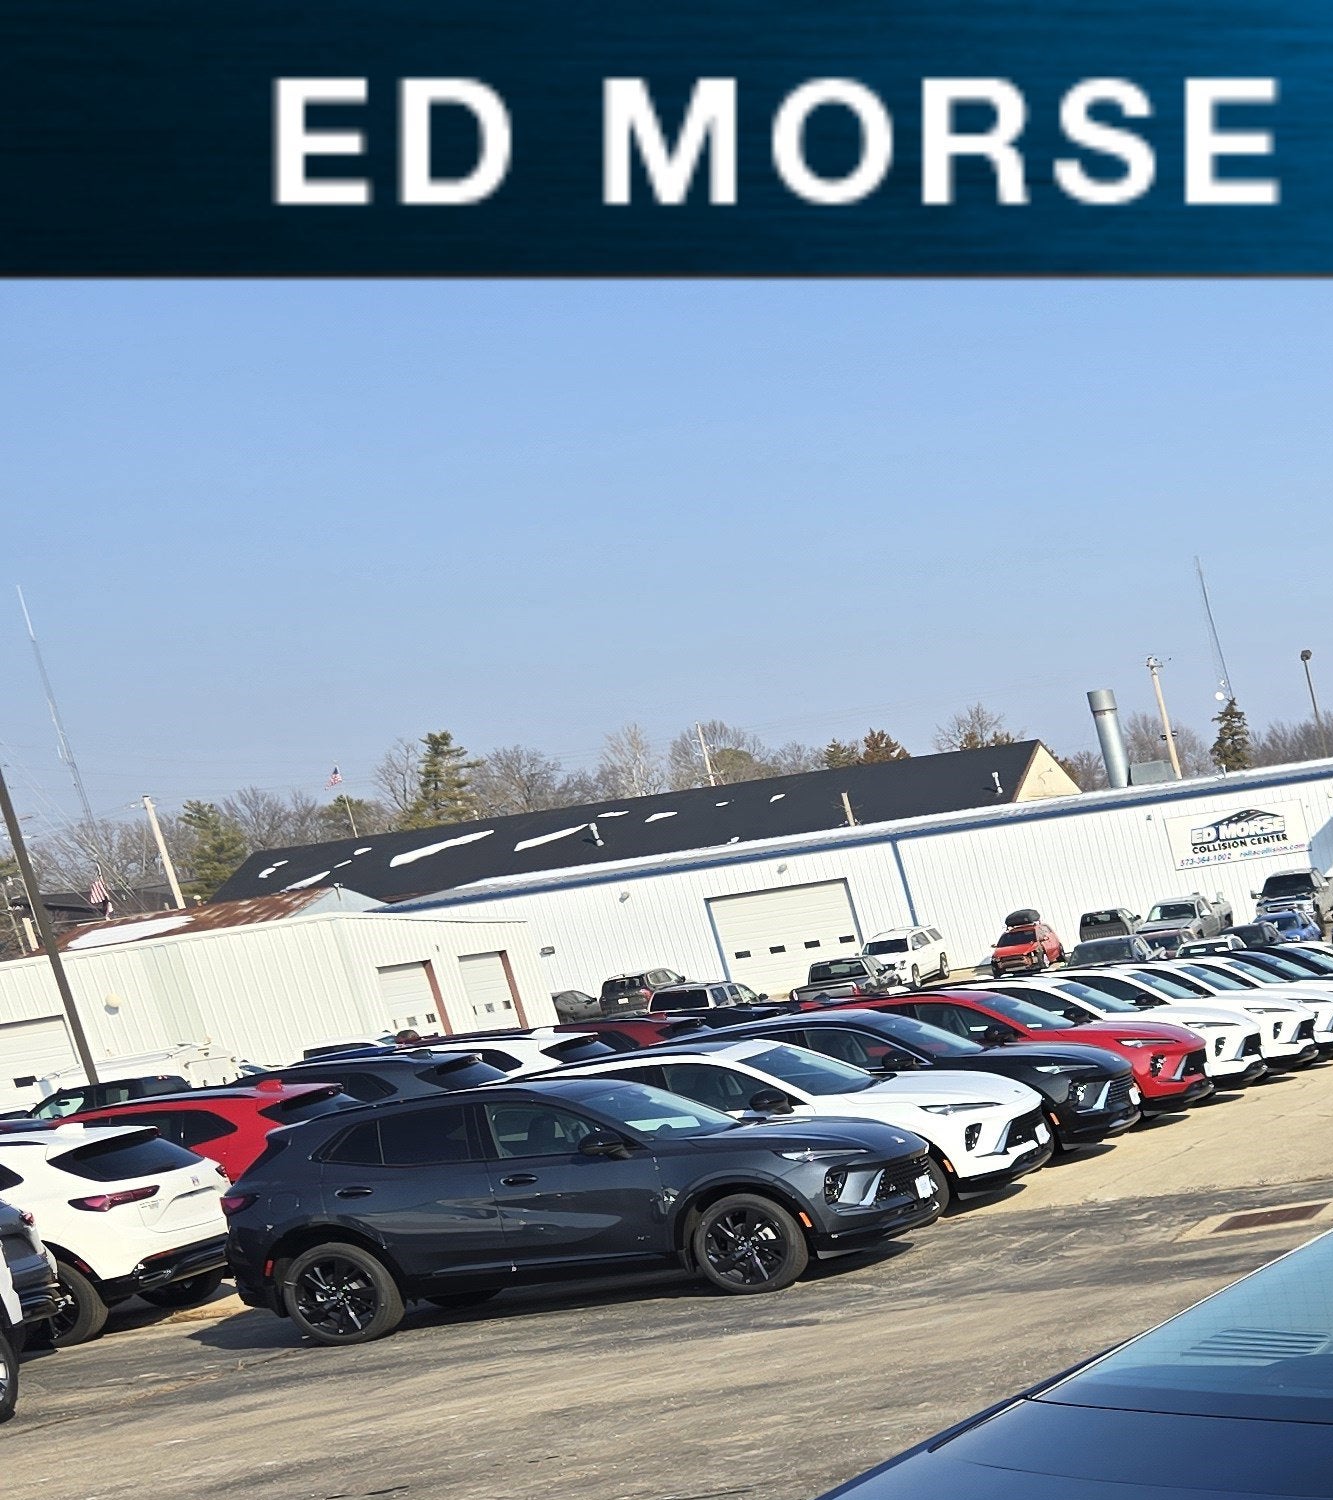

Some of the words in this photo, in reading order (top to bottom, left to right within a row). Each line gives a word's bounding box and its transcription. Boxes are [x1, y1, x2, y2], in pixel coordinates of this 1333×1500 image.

[1191, 826, 1217, 845] ED
[1219, 816, 1286, 841] MORSE
[1192, 840, 1248, 855] COLLISION
[1250, 833, 1289, 846] CENTER
